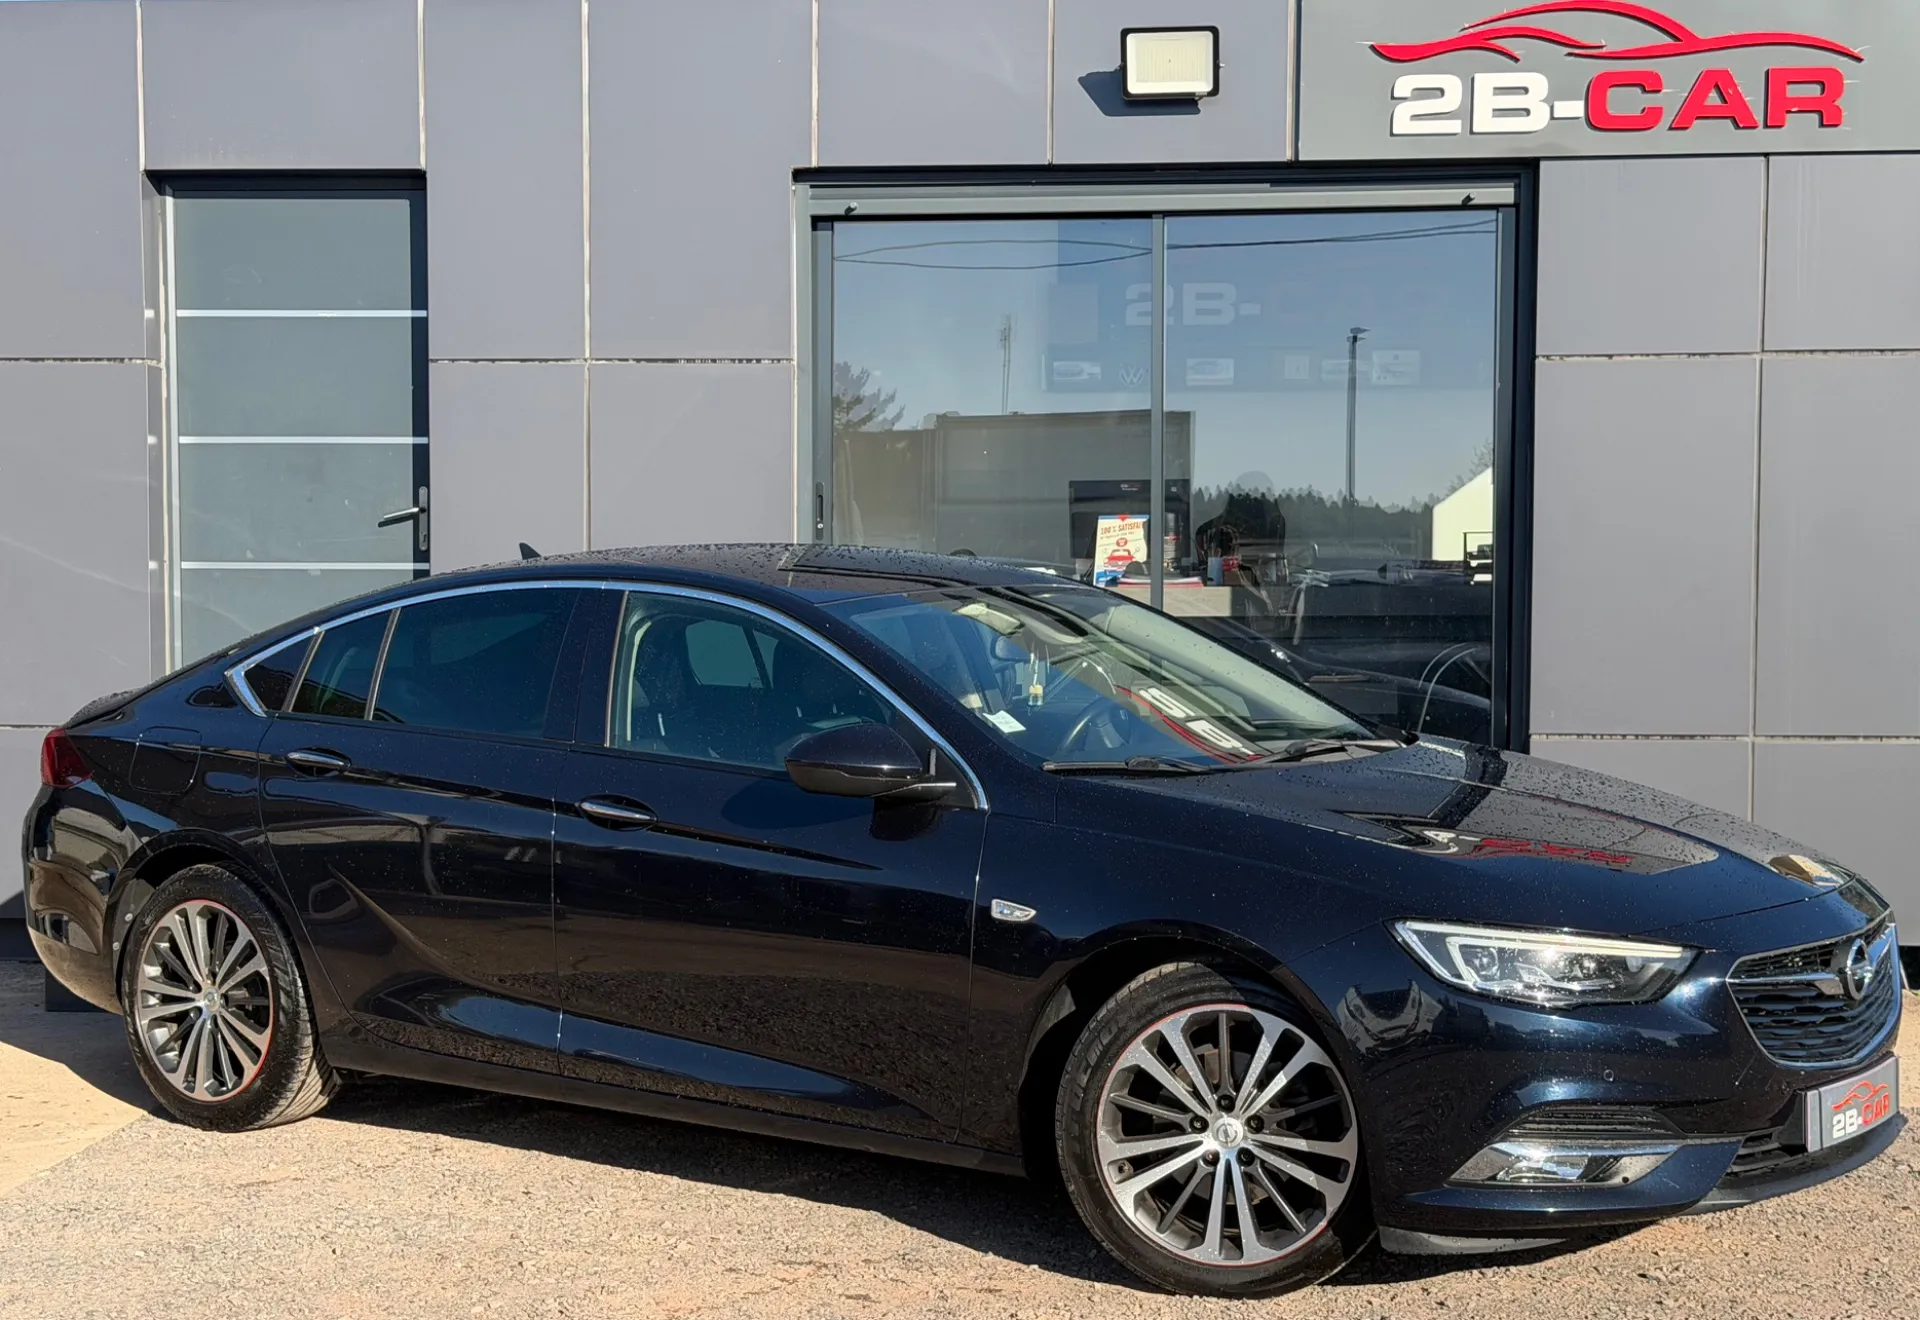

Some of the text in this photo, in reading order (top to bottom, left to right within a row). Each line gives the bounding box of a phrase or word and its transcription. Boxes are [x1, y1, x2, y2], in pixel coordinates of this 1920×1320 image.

[1392, 67, 1846, 135] 2B-CAR
[1100, 526, 1112, 535] 100
[1832, 1093, 1890, 1139] 2B-CAR
